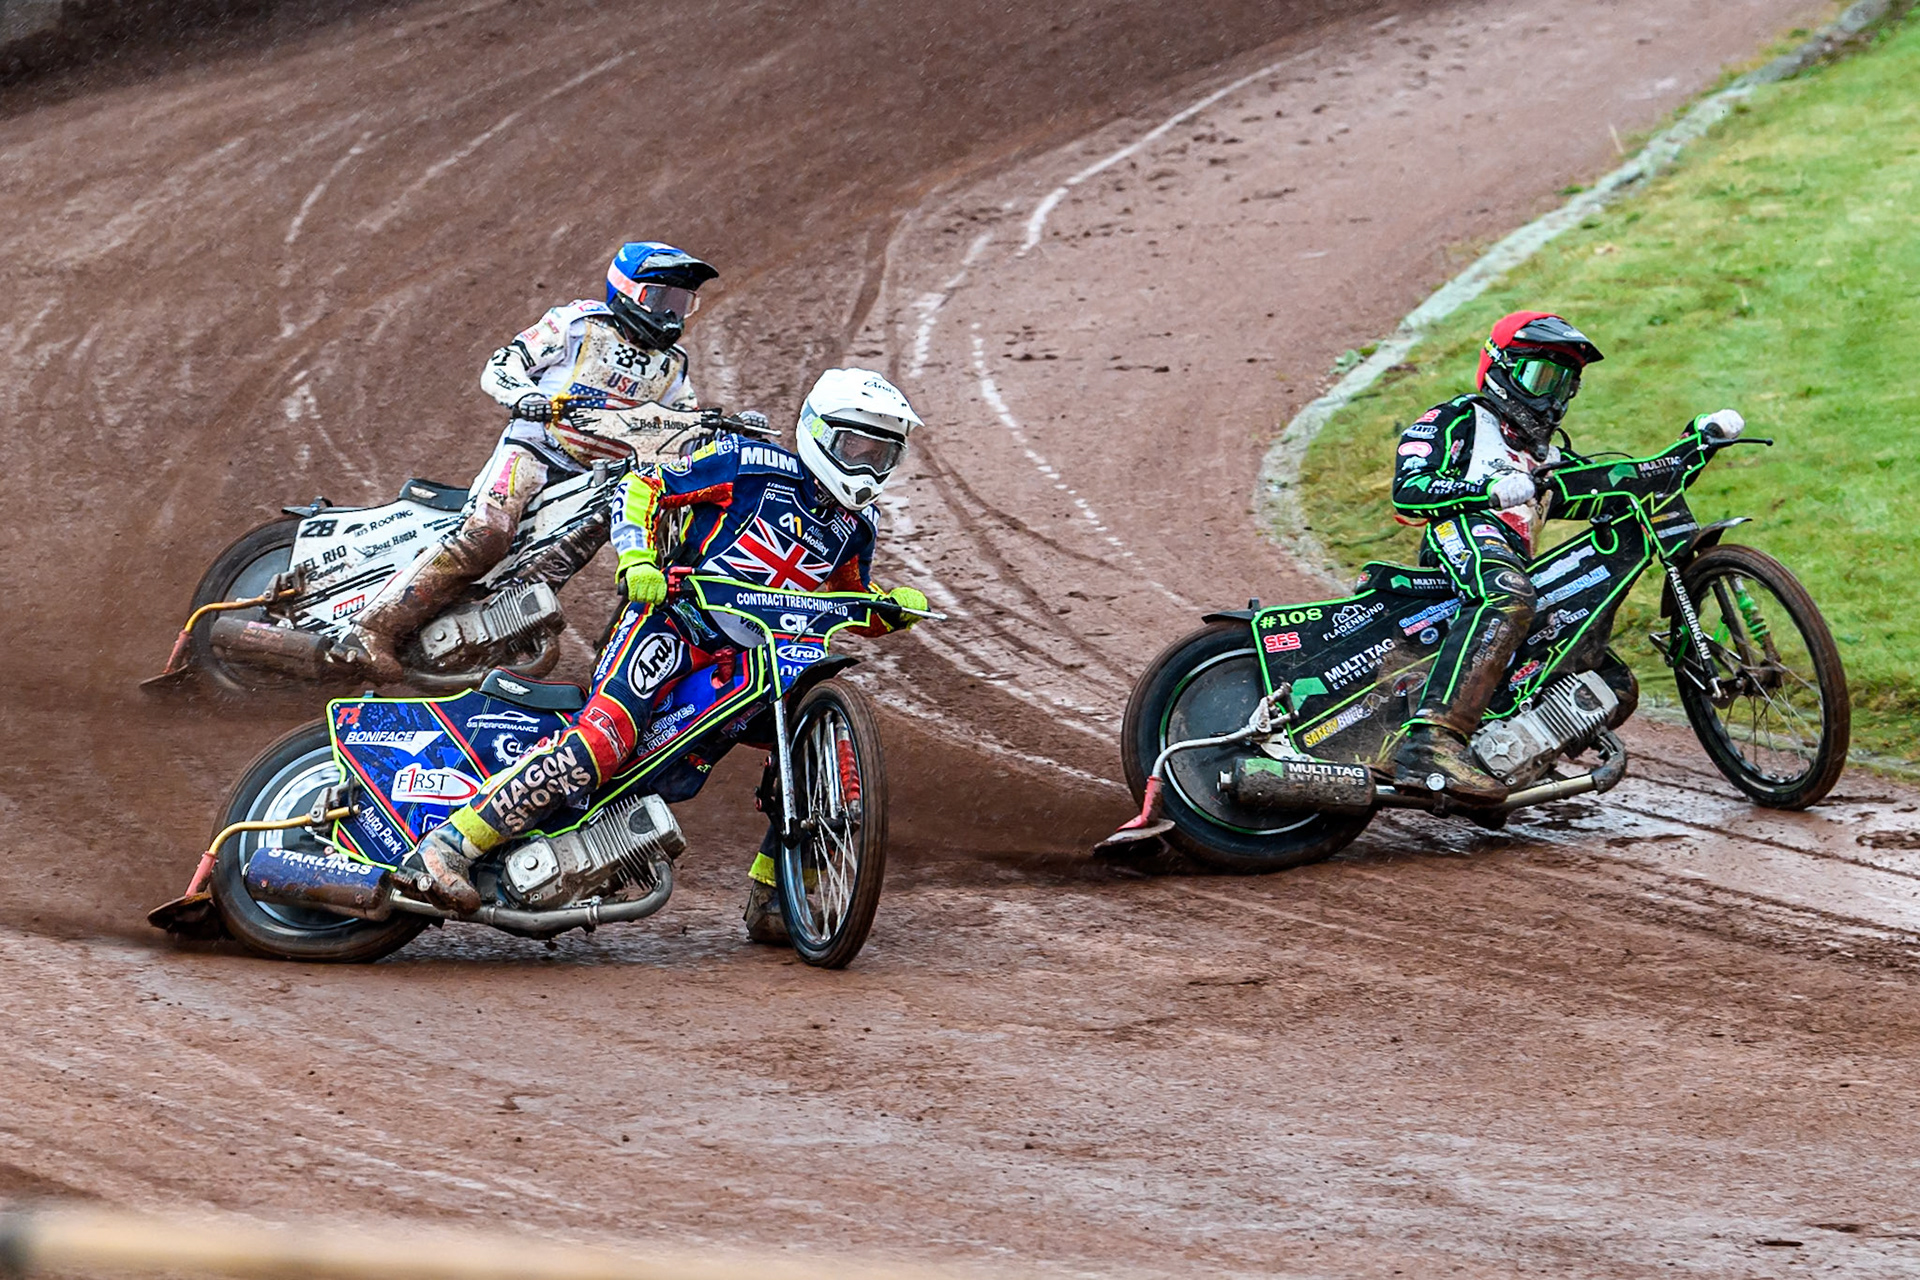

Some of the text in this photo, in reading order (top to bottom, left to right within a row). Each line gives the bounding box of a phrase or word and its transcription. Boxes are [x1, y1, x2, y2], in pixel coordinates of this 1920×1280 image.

[607, 372, 640, 397] USA
[741, 446, 799, 474] MUM
[1638, 458, 1666, 472] MULTI
[300, 519, 338, 538] 28
[369, 509, 414, 531] ROOFING
[322, 545, 347, 565] RIO
[372, 539, 391, 552] Boat
[801, 532, 830, 557] Mobility
[305, 561, 346, 585] Racing
[333, 594, 366, 621] UNI
[736, 592, 785, 605] CONTRACT
[785, 595, 833, 613] TRENCHING
[1667, 566, 1711, 660] FALDSIKRING.NU
[1260, 607, 1323, 629] #108
[1322, 602, 1385, 641] FLADENBUND
[781, 645, 820, 660] Arai
[1324, 638, 1396, 683] MULTI TAG
[638, 638, 673, 694] Arai
[1332, 655, 1388, 691] ENTREPR
[336, 707, 361, 725] 72
[477, 721, 539, 733] PERFORMANCE
[651, 703, 696, 734] STOVES
[345, 730, 415, 743] BONIFACE
[397, 767, 450, 793] F1RST
[490, 746, 578, 818] HAGON
[1288, 762, 1365, 778] MULTI TAG
[503, 766, 591, 833] SHOCKS
[361, 805, 402, 855] Auto Park
[268, 848, 373, 875] STARLINGS
